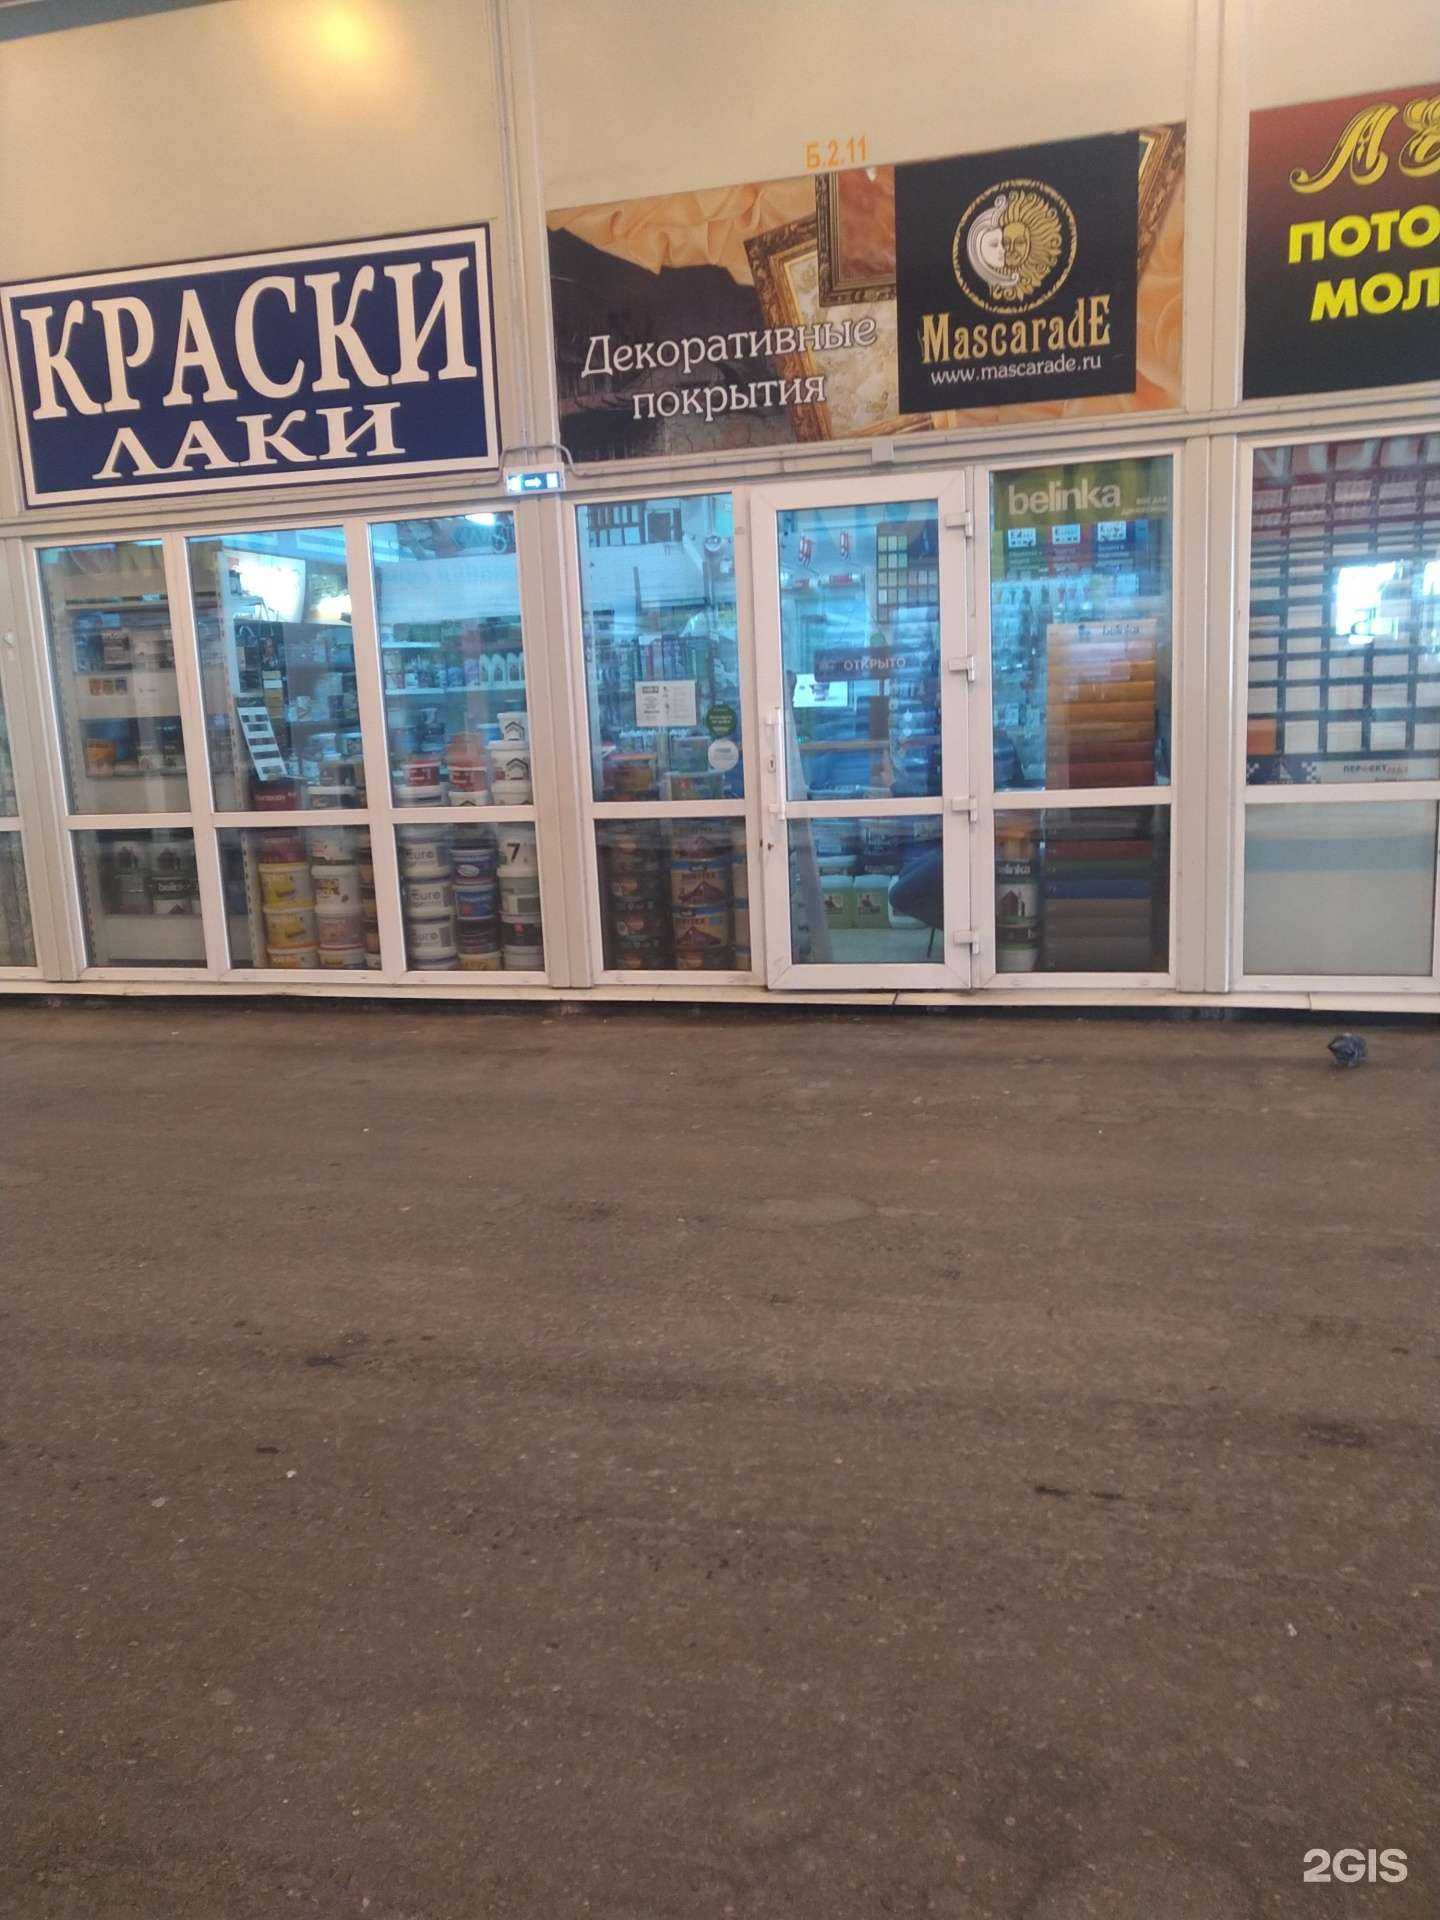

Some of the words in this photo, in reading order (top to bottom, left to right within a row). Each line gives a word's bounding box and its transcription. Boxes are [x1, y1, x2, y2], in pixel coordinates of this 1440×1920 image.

[1309, 266, 1440, 321] МОЛ
[20, 256, 478, 421] КРАСКИ
[580, 317, 877, 379] Декоративные
[930, 353, 1103, 386] www.mascarade.ru
[632, 375, 827, 423] покрытия
[92, 401, 406, 480] ЛАКИ
[1008, 477, 1122, 516] belinka
[843, 657, 906, 672] ОТКРЫТО
[506, 842, 521, 863] 7
